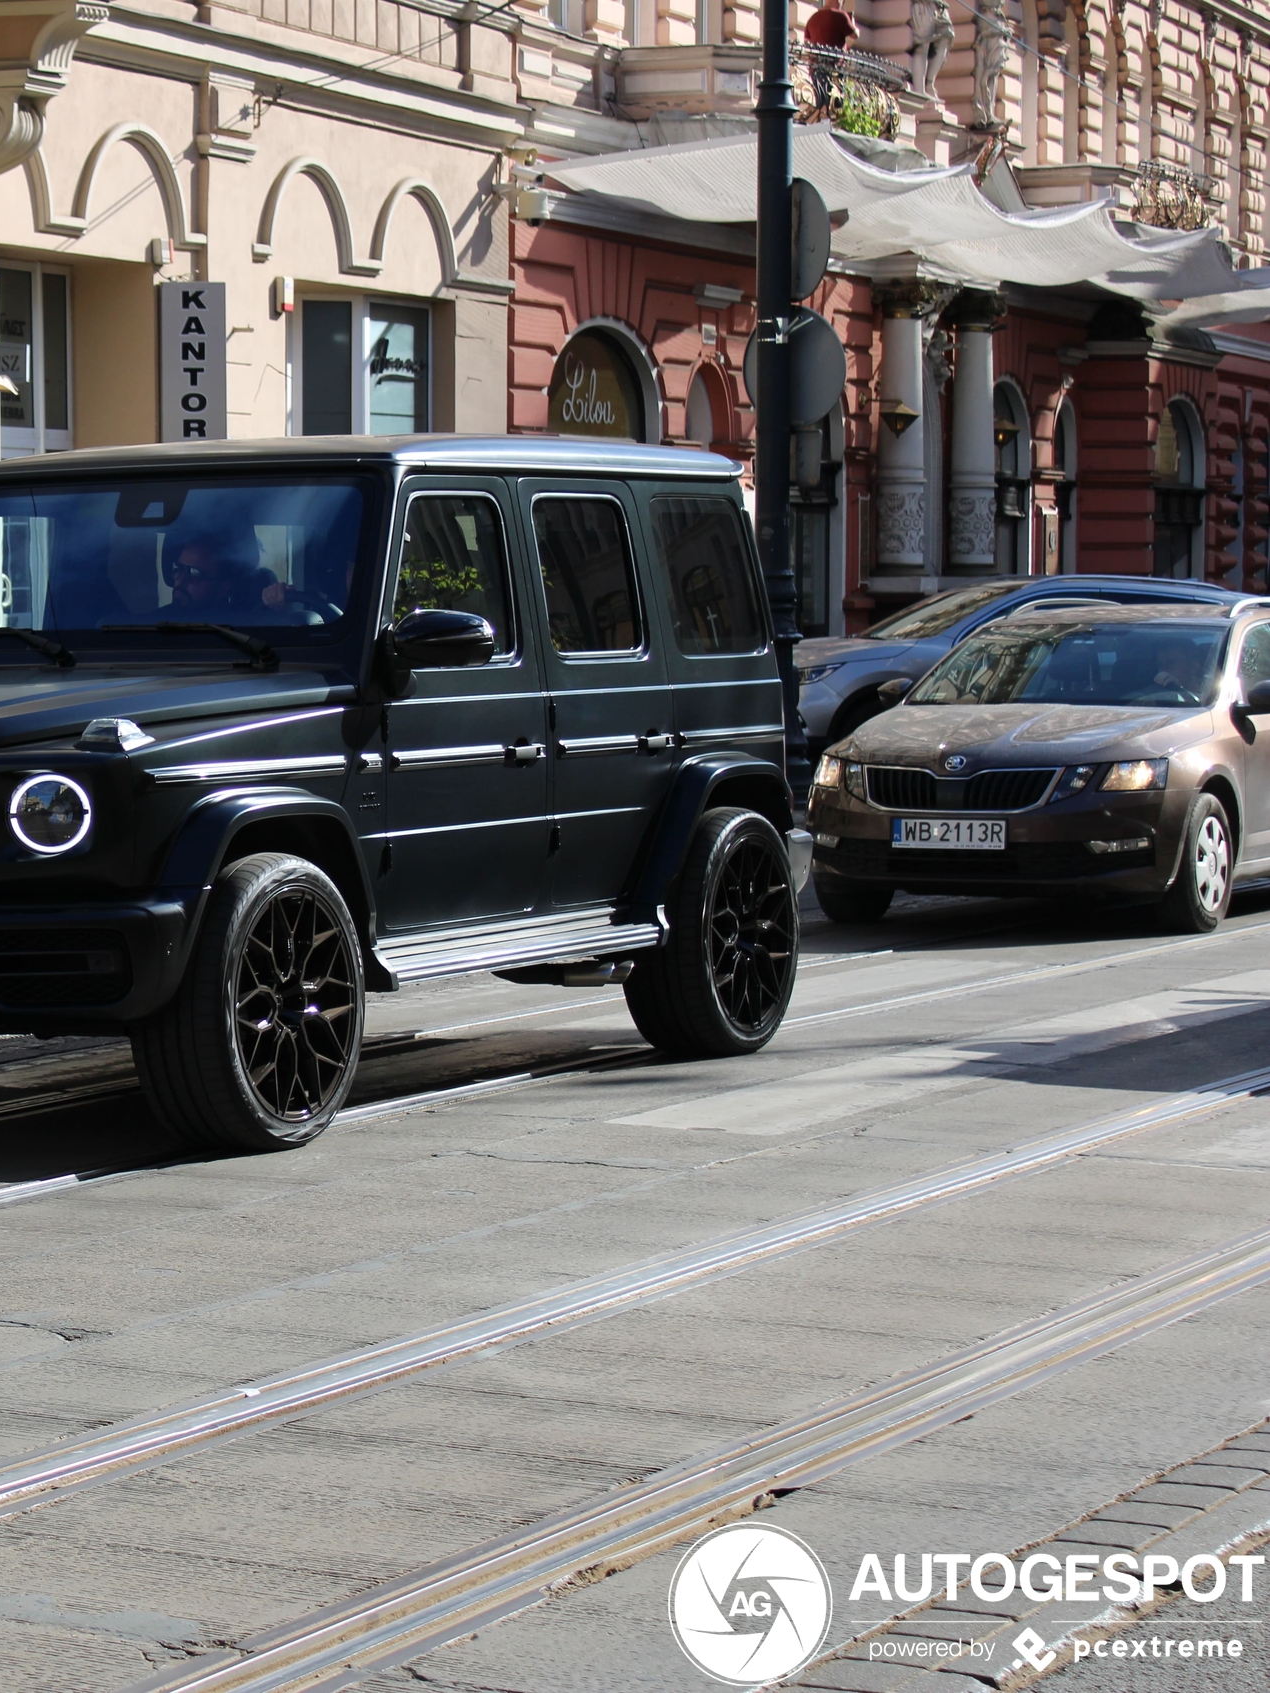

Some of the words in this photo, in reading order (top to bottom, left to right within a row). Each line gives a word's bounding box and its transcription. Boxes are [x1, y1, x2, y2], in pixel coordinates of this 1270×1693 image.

[181, 290, 208, 438] KANTOR
[562, 351, 616, 425] Lilou
[904, 821, 932, 842] WB
[939, 822, 1003, 843] 2113R
